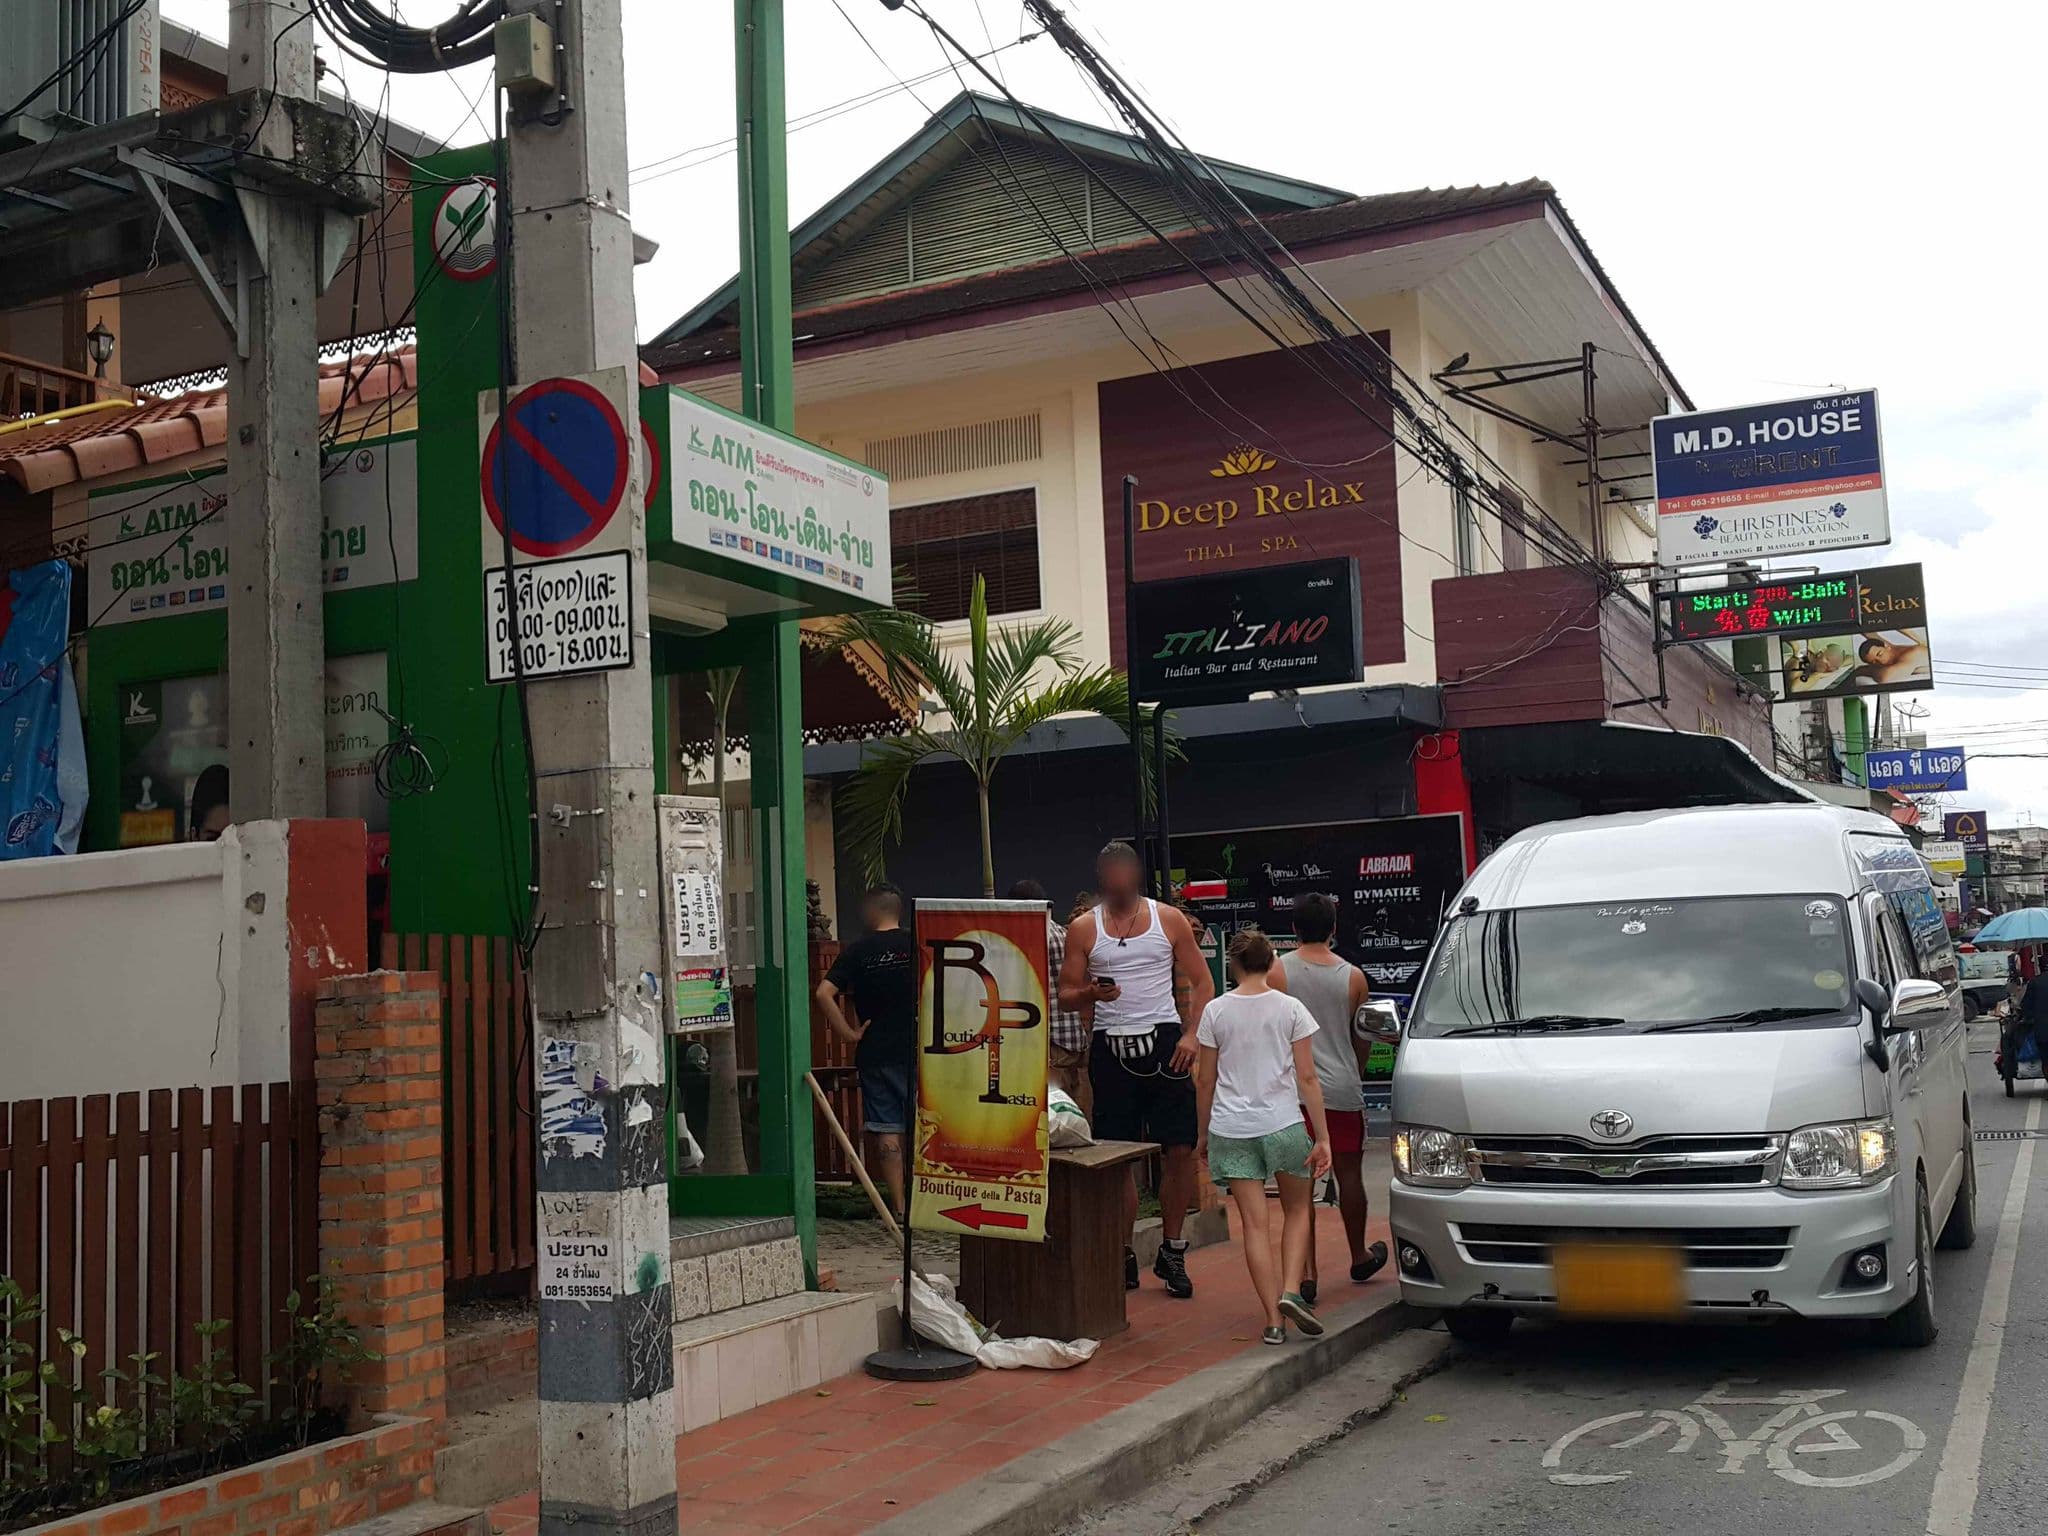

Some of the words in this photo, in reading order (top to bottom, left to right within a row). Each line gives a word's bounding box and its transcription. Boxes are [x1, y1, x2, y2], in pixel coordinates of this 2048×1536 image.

[1673, 426, 1743, 455] M.D.
[1749, 408, 1862, 445] HOUSE
[711, 433, 755, 475] ATM
[1137, 498, 1239, 532] Deep
[1252, 478, 1367, 517] Relax
[143, 502, 198, 536] ATM
[1719, 508, 1828, 534] CHRISTINE'S
[1719, 531, 1760, 544] BEAUTY
[1777, 521, 1850, 538] RELAXATION
[1185, 543, 1234, 562] THAI
[1261, 535, 1298, 553] SPA
[1152, 615, 1329, 659] ITALIANO
[1164, 666, 1201, 679] Italian
[1206, 663, 1226, 675] Bar
[1231, 658, 1252, 671] and
[1258, 654, 1318, 671] Restaurant
[1869, 759, 1904, 778] แอล
[1909, 751, 1922, 775] พี
[1359, 854, 1412, 875] LABRADA
[1354, 886, 1422, 900] DYMATIZE
[697, 922, 706, 938] 24
[1360, 938, 1373, 948] JAY
[1374, 936, 1400, 947] CUTLER
[918, 1177, 978, 1200] Boutique
[980, 1189, 1001, 1201] della
[1004, 1185, 1042, 1206] Pasta
[546, 1241, 609, 1257] ปะยาง
[555, 1267, 570, 1279] 24
[573, 1260, 600, 1279] ชั่วโมง
[545, 1285, 612, 1297] 081-5953654
